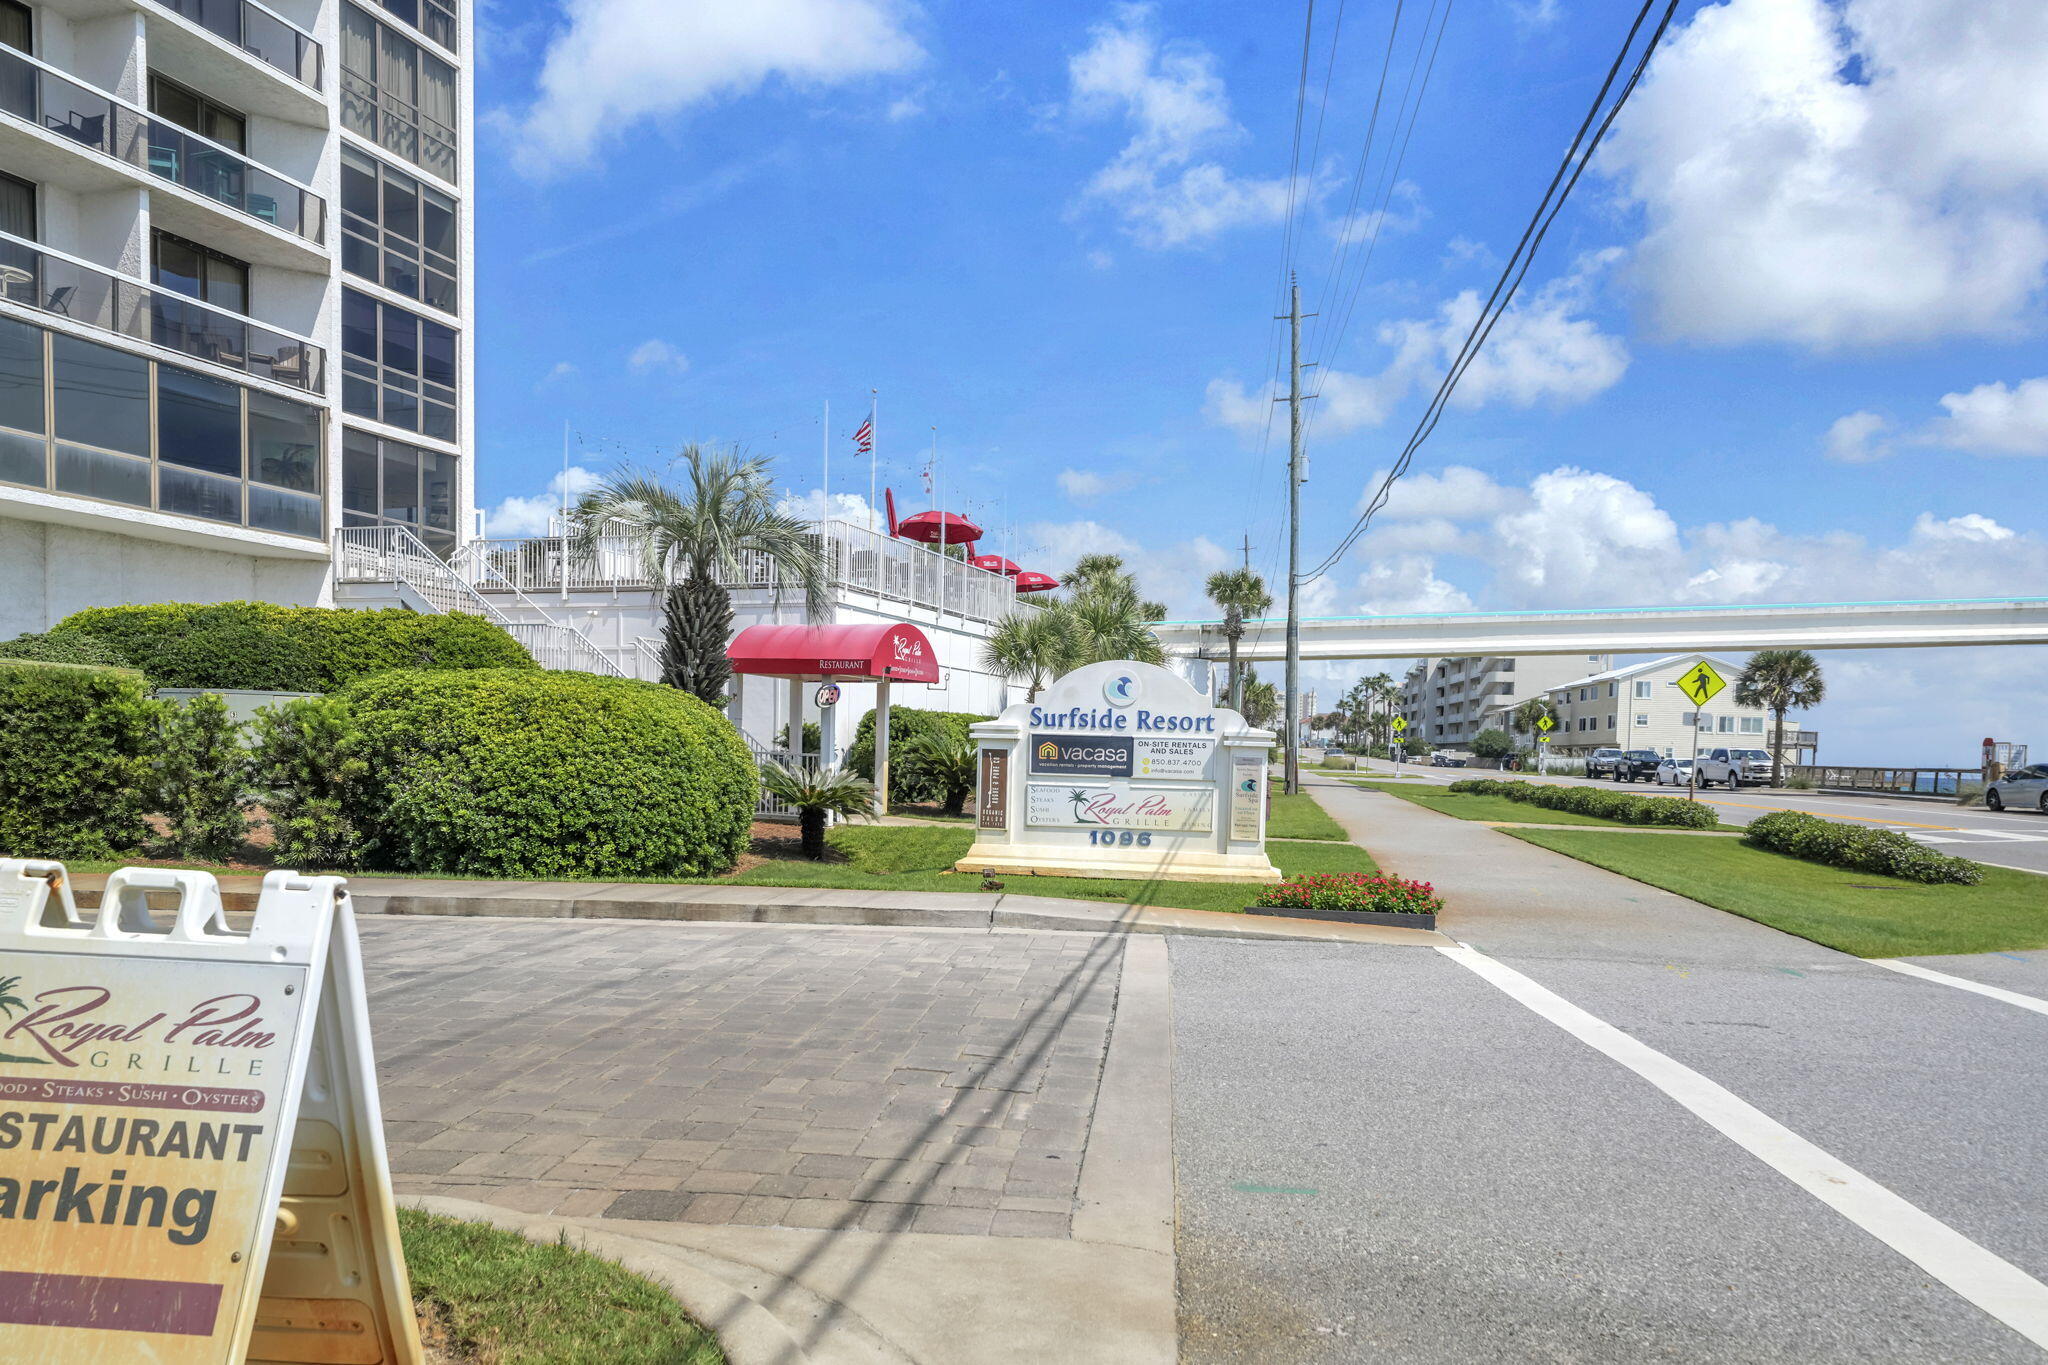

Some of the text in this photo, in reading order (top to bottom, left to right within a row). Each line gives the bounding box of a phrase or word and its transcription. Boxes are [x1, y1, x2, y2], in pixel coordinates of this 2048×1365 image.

[819, 659, 865, 669] RESTAURANT
[818, 688, 839, 703] OPEN
[1029, 706, 1215, 732] Surfside Resort
[1061, 747, 1128, 762] vacasa
[1169, 748, 1194, 756] SALES
[1151, 758, 1202, 767] 850.837.4700
[1084, 793, 1174, 825] Royal Palm
[1112, 817, 1170, 827] GRILLE
[1090, 830, 1152, 846] 1096
[3, 986, 276, 1067] Royal Palm
[90, 1050, 264, 1076] GRILLE
[41, 1081, 105, 1099] STEAKS
[118, 1085, 168, 1102] SUSHI
[181, 1088, 260, 1107] OYSTERS
[0, 1111, 264, 1162] STAURANT
